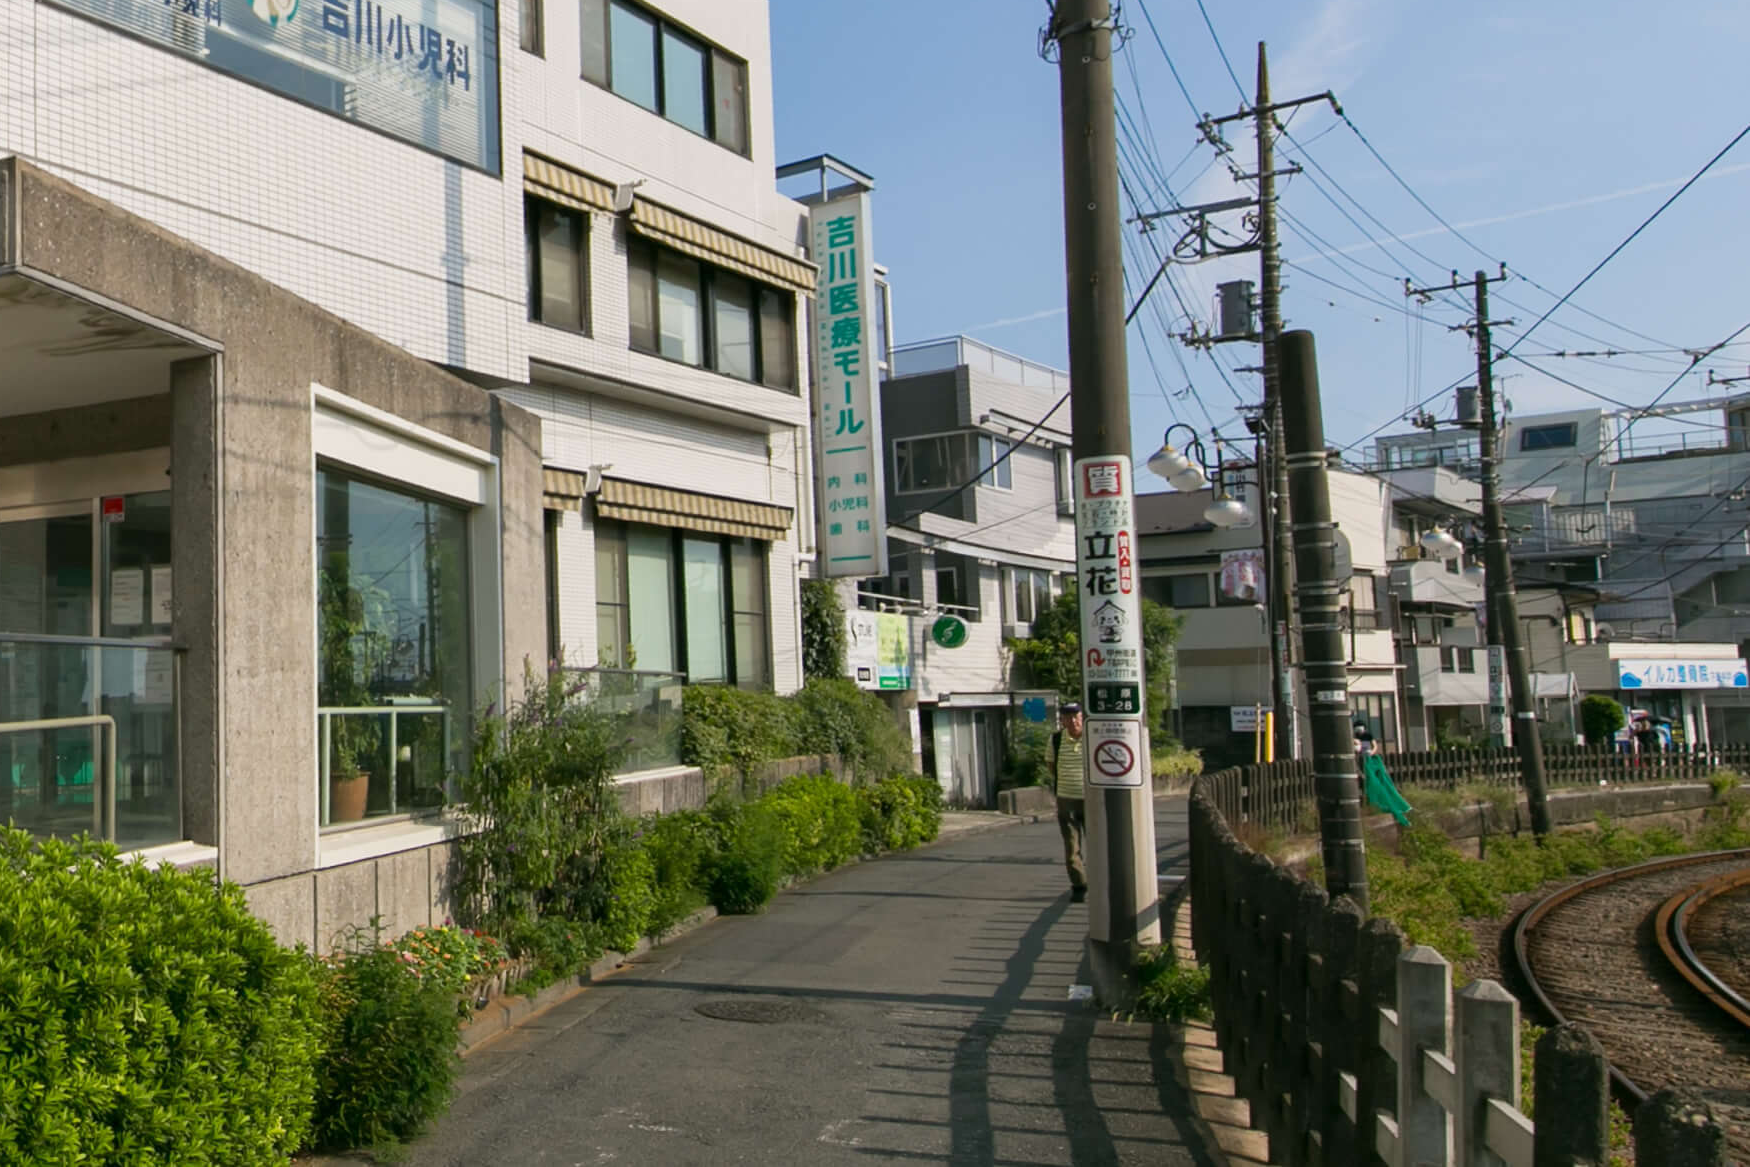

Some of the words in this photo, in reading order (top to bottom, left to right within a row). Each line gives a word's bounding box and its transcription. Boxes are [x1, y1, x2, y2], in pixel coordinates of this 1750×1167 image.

[826, 215, 865, 437] 吉川医療モール
[827, 472, 867, 490] 内科
[1087, 465, 1120, 496] 質
[828, 495, 869, 513] 小児科
[829, 519, 870, 536] 歯科
[1084, 531, 1118, 597] 立花
[1643, 664, 1709, 683] イルカ整骨院
[1097, 700, 1133, 711] 3-28
